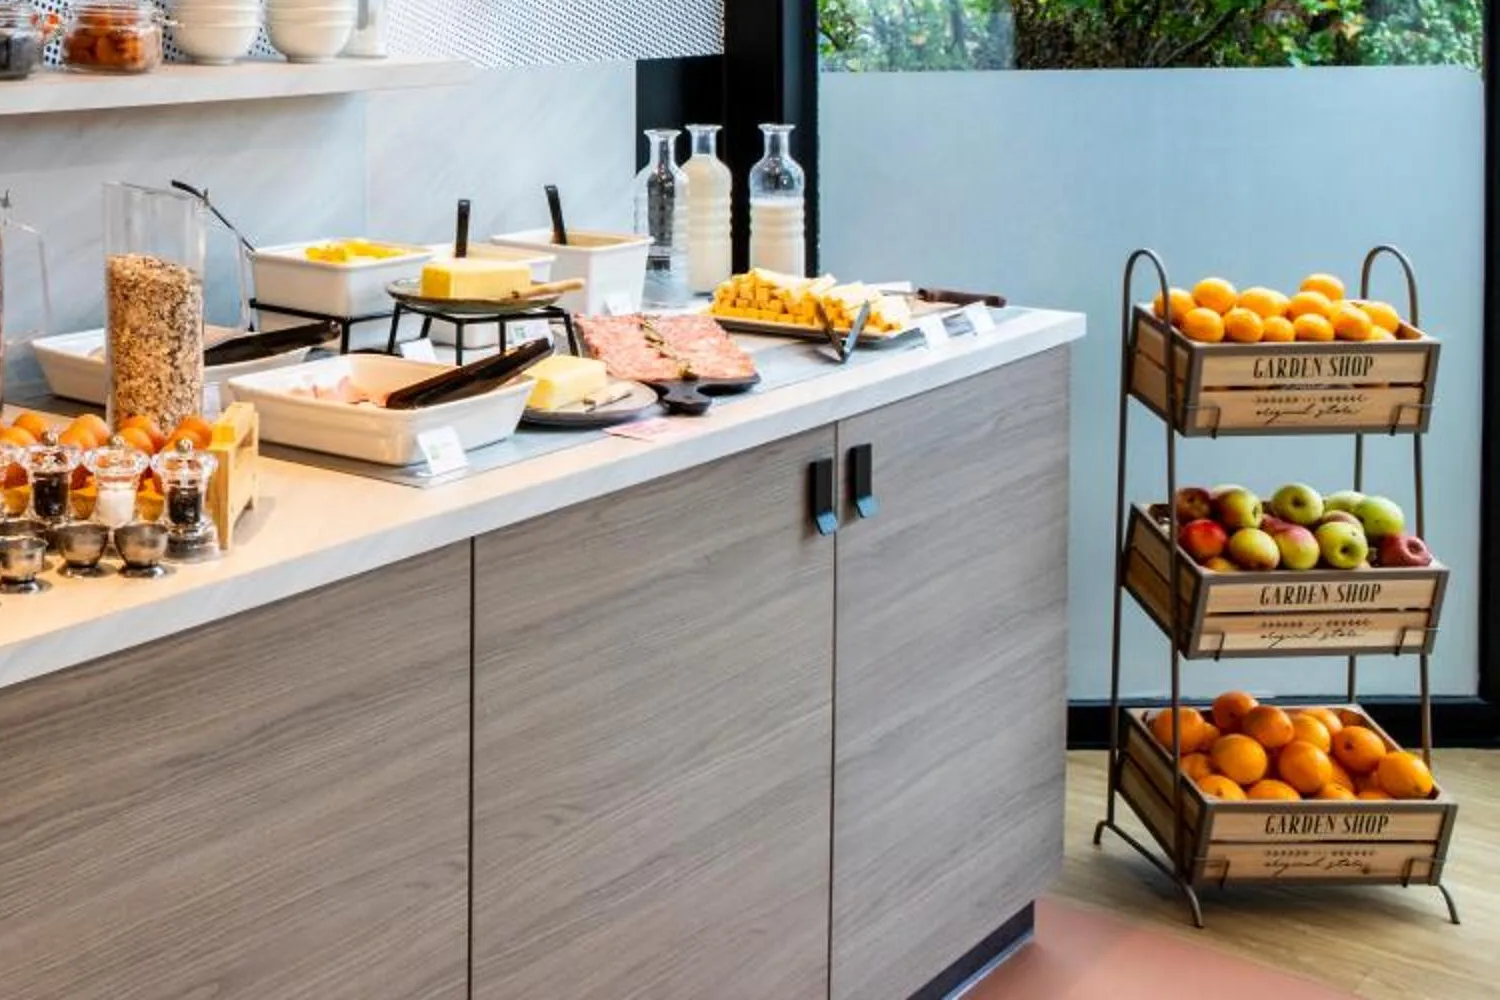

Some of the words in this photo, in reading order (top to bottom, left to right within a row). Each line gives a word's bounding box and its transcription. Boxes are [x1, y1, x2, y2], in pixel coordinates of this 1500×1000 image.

[1253, 357, 1324, 379] GARDEN
[1327, 355, 1374, 377] SHOP
[1260, 584, 1329, 606] GARDEN
[1335, 583, 1381, 604] SHOP
[1265, 815, 1337, 835] GARDEN
[1342, 815, 1390, 835] SHOP
